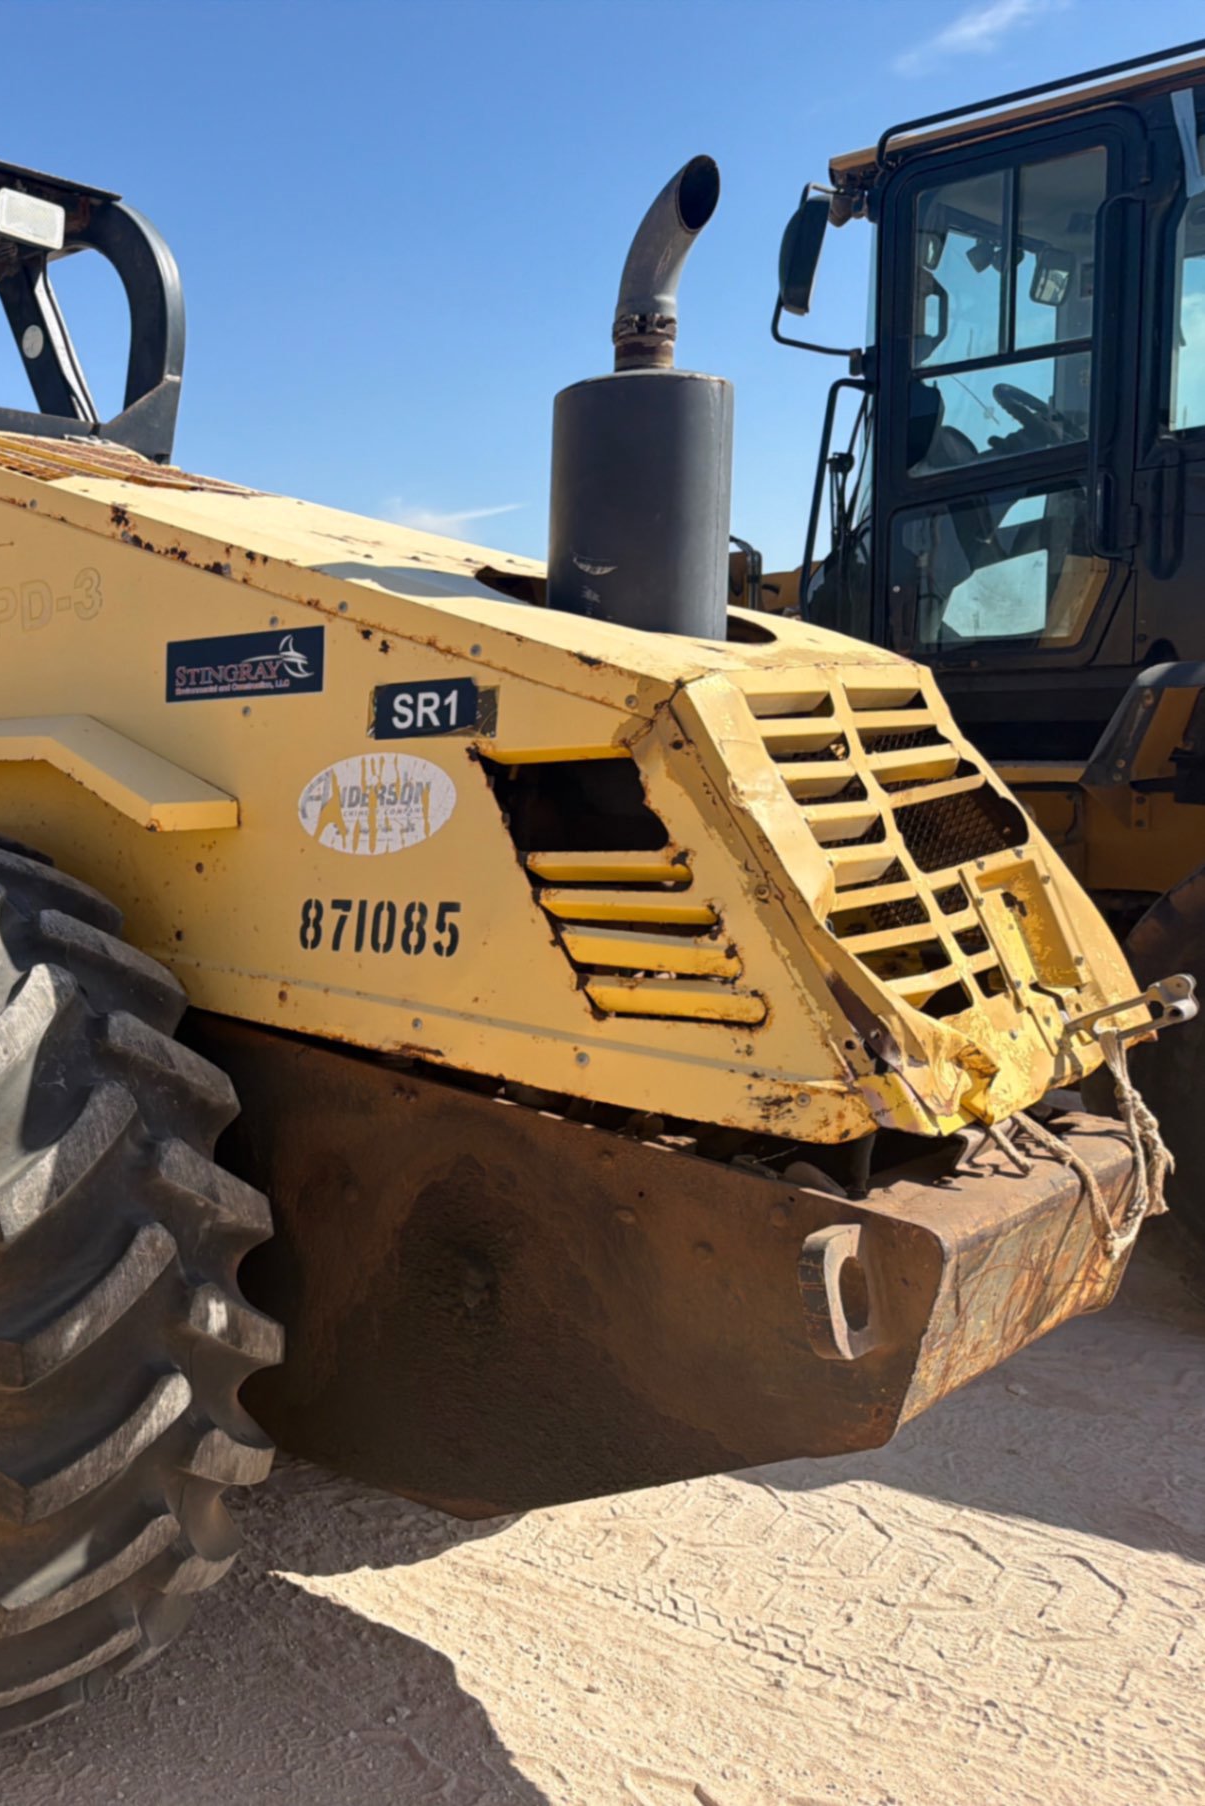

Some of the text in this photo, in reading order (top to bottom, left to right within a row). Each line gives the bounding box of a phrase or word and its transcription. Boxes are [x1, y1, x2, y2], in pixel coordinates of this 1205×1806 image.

[175, 661, 284, 687] STINGRAY
[219, 683, 231, 693] and
[275, 679, 291, 688] LLC
[391, 689, 459, 730] SR1
[299, 898, 462, 958] 871085
